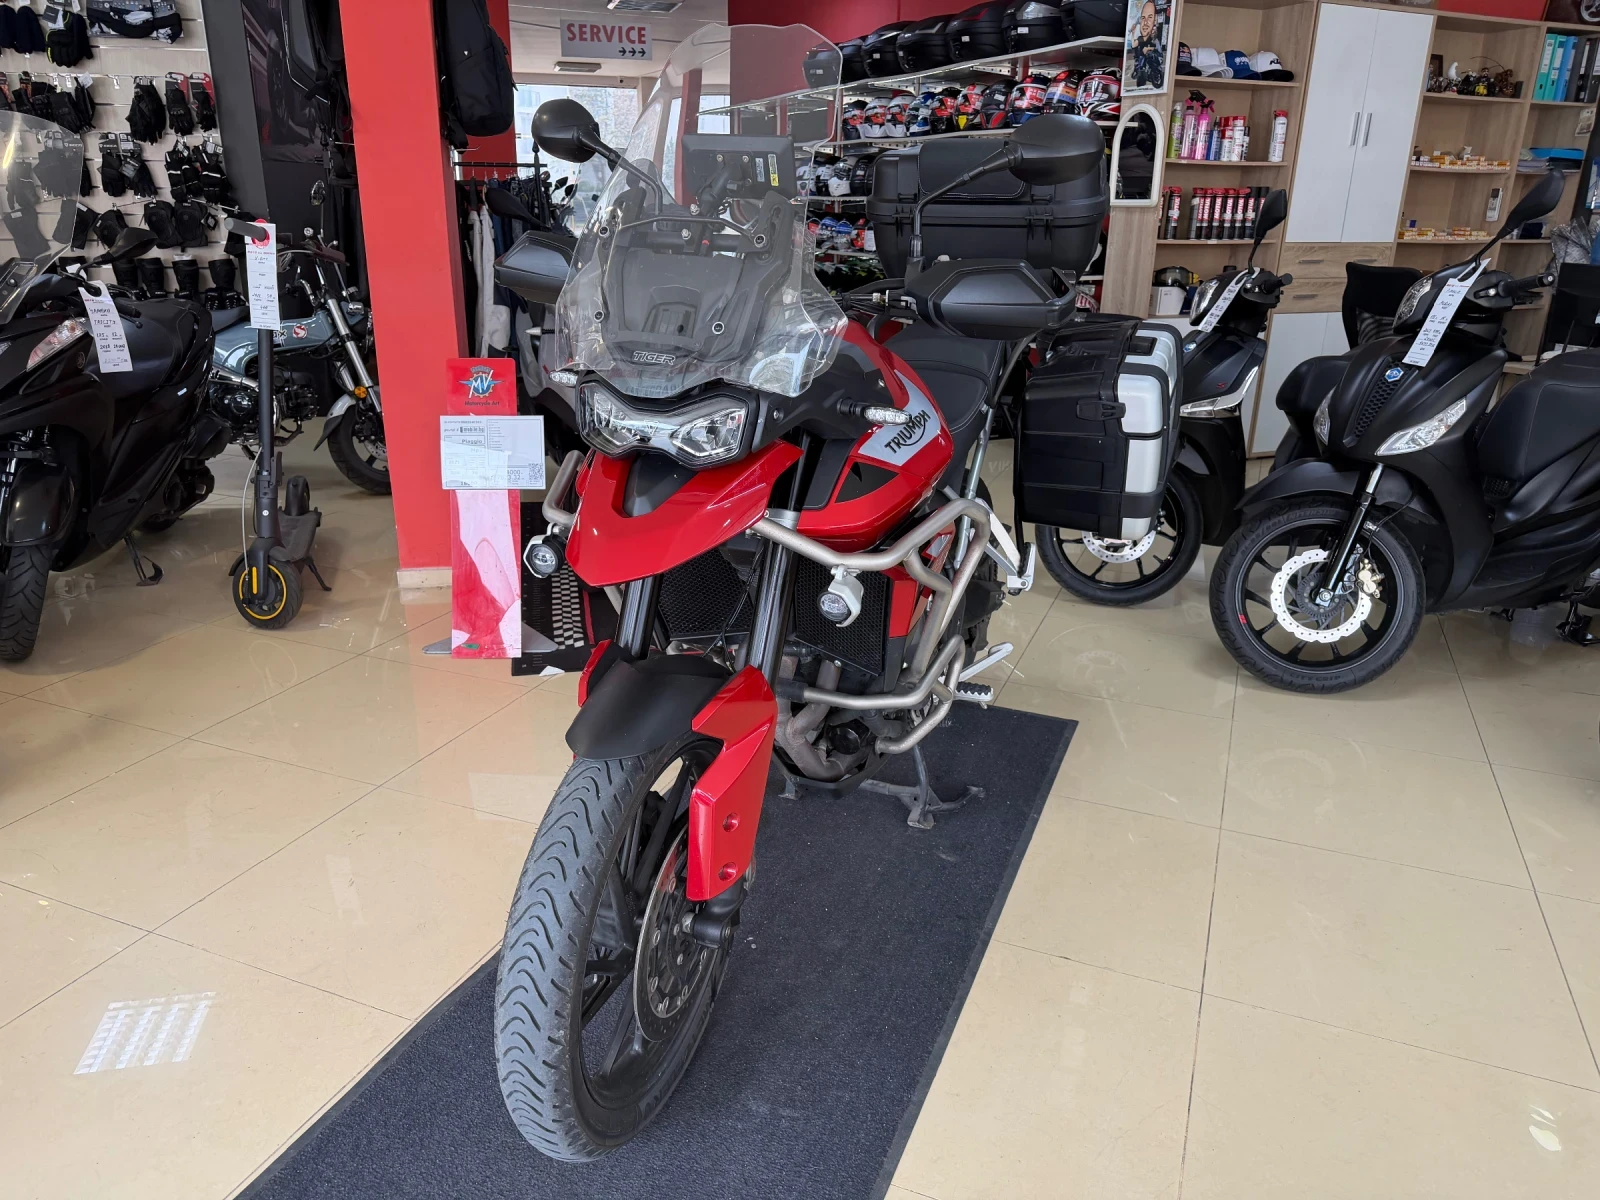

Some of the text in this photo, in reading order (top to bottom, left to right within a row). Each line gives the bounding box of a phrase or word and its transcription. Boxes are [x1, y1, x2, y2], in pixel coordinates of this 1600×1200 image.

[566, 23, 647, 45] SERVICE
[1203, 197, 1211, 219] MOTUL
[1214, 197, 1223, 219] MOTUL
[633, 350, 676, 366] TIGER
[884, 409, 931, 454] TRIUMPH
